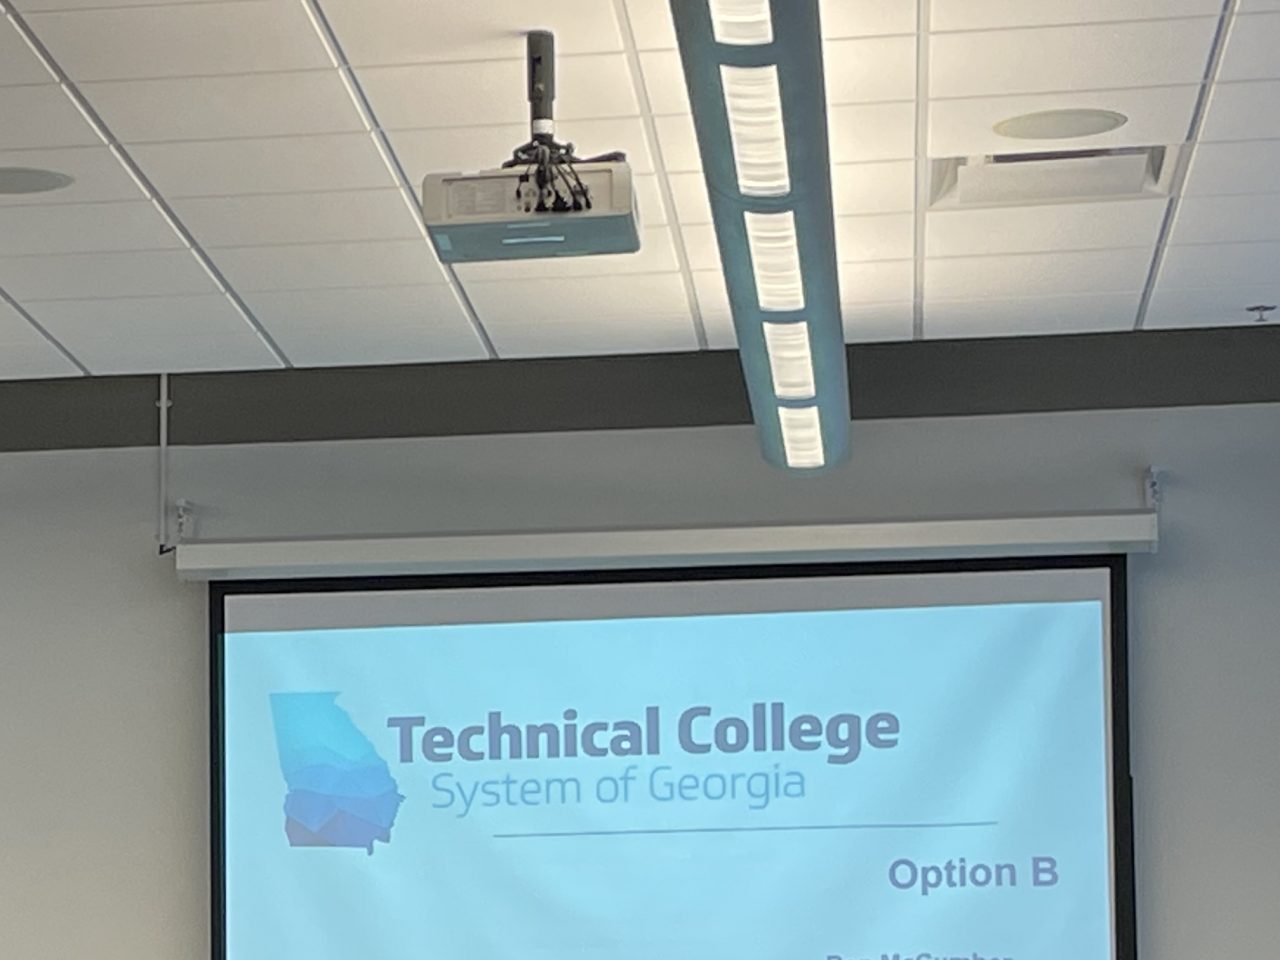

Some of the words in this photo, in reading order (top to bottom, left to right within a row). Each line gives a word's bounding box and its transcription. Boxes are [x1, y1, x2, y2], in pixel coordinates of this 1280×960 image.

[387, 706, 660, 763] Technical
[677, 702, 900, 765] College
[431, 771, 581, 818] System
[595, 765, 638, 803] of
[648, 763, 806, 810] Georgia
[888, 857, 1017, 896] Option
[1032, 856, 1059, 887] B
